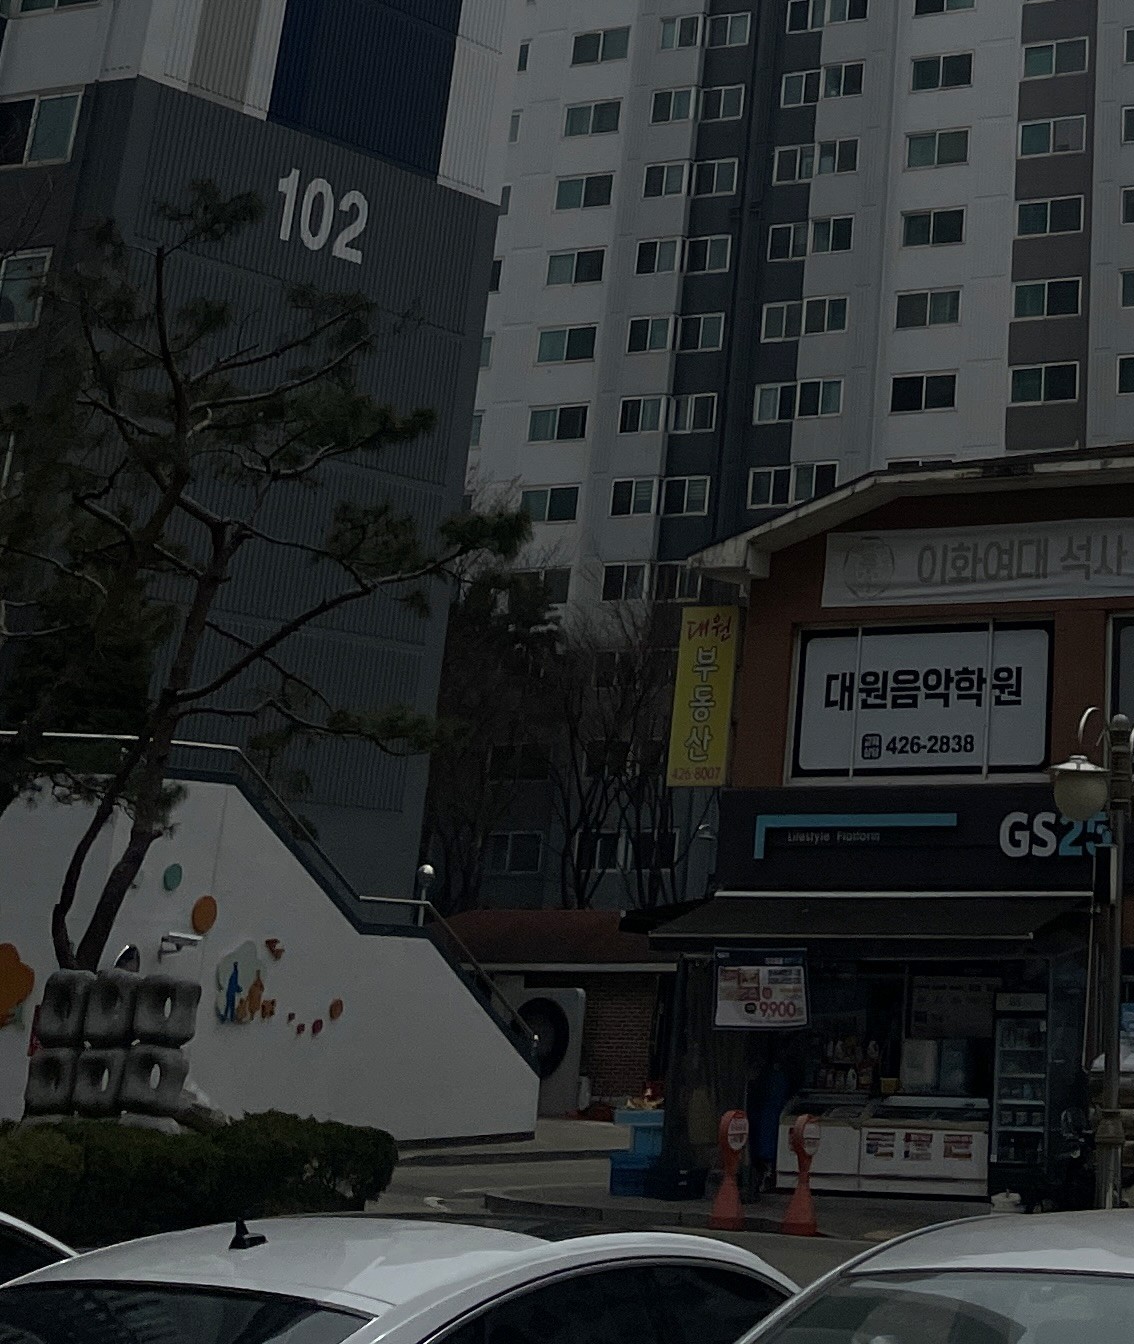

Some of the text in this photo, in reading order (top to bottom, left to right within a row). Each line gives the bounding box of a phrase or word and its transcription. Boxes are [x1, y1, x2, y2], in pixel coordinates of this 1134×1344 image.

[278, 168, 369, 265] 102
[917, 537, 1050, 586] 이화여대
[1060, 533, 1129, 580] 석사
[687, 613, 732, 642] 대원
[684, 645, 720, 762] 부동산
[824, 665, 1023, 711] 대원음악학원
[886, 734, 975, 755] 426-2838
[1000, 811, 1113, 858] GS25
